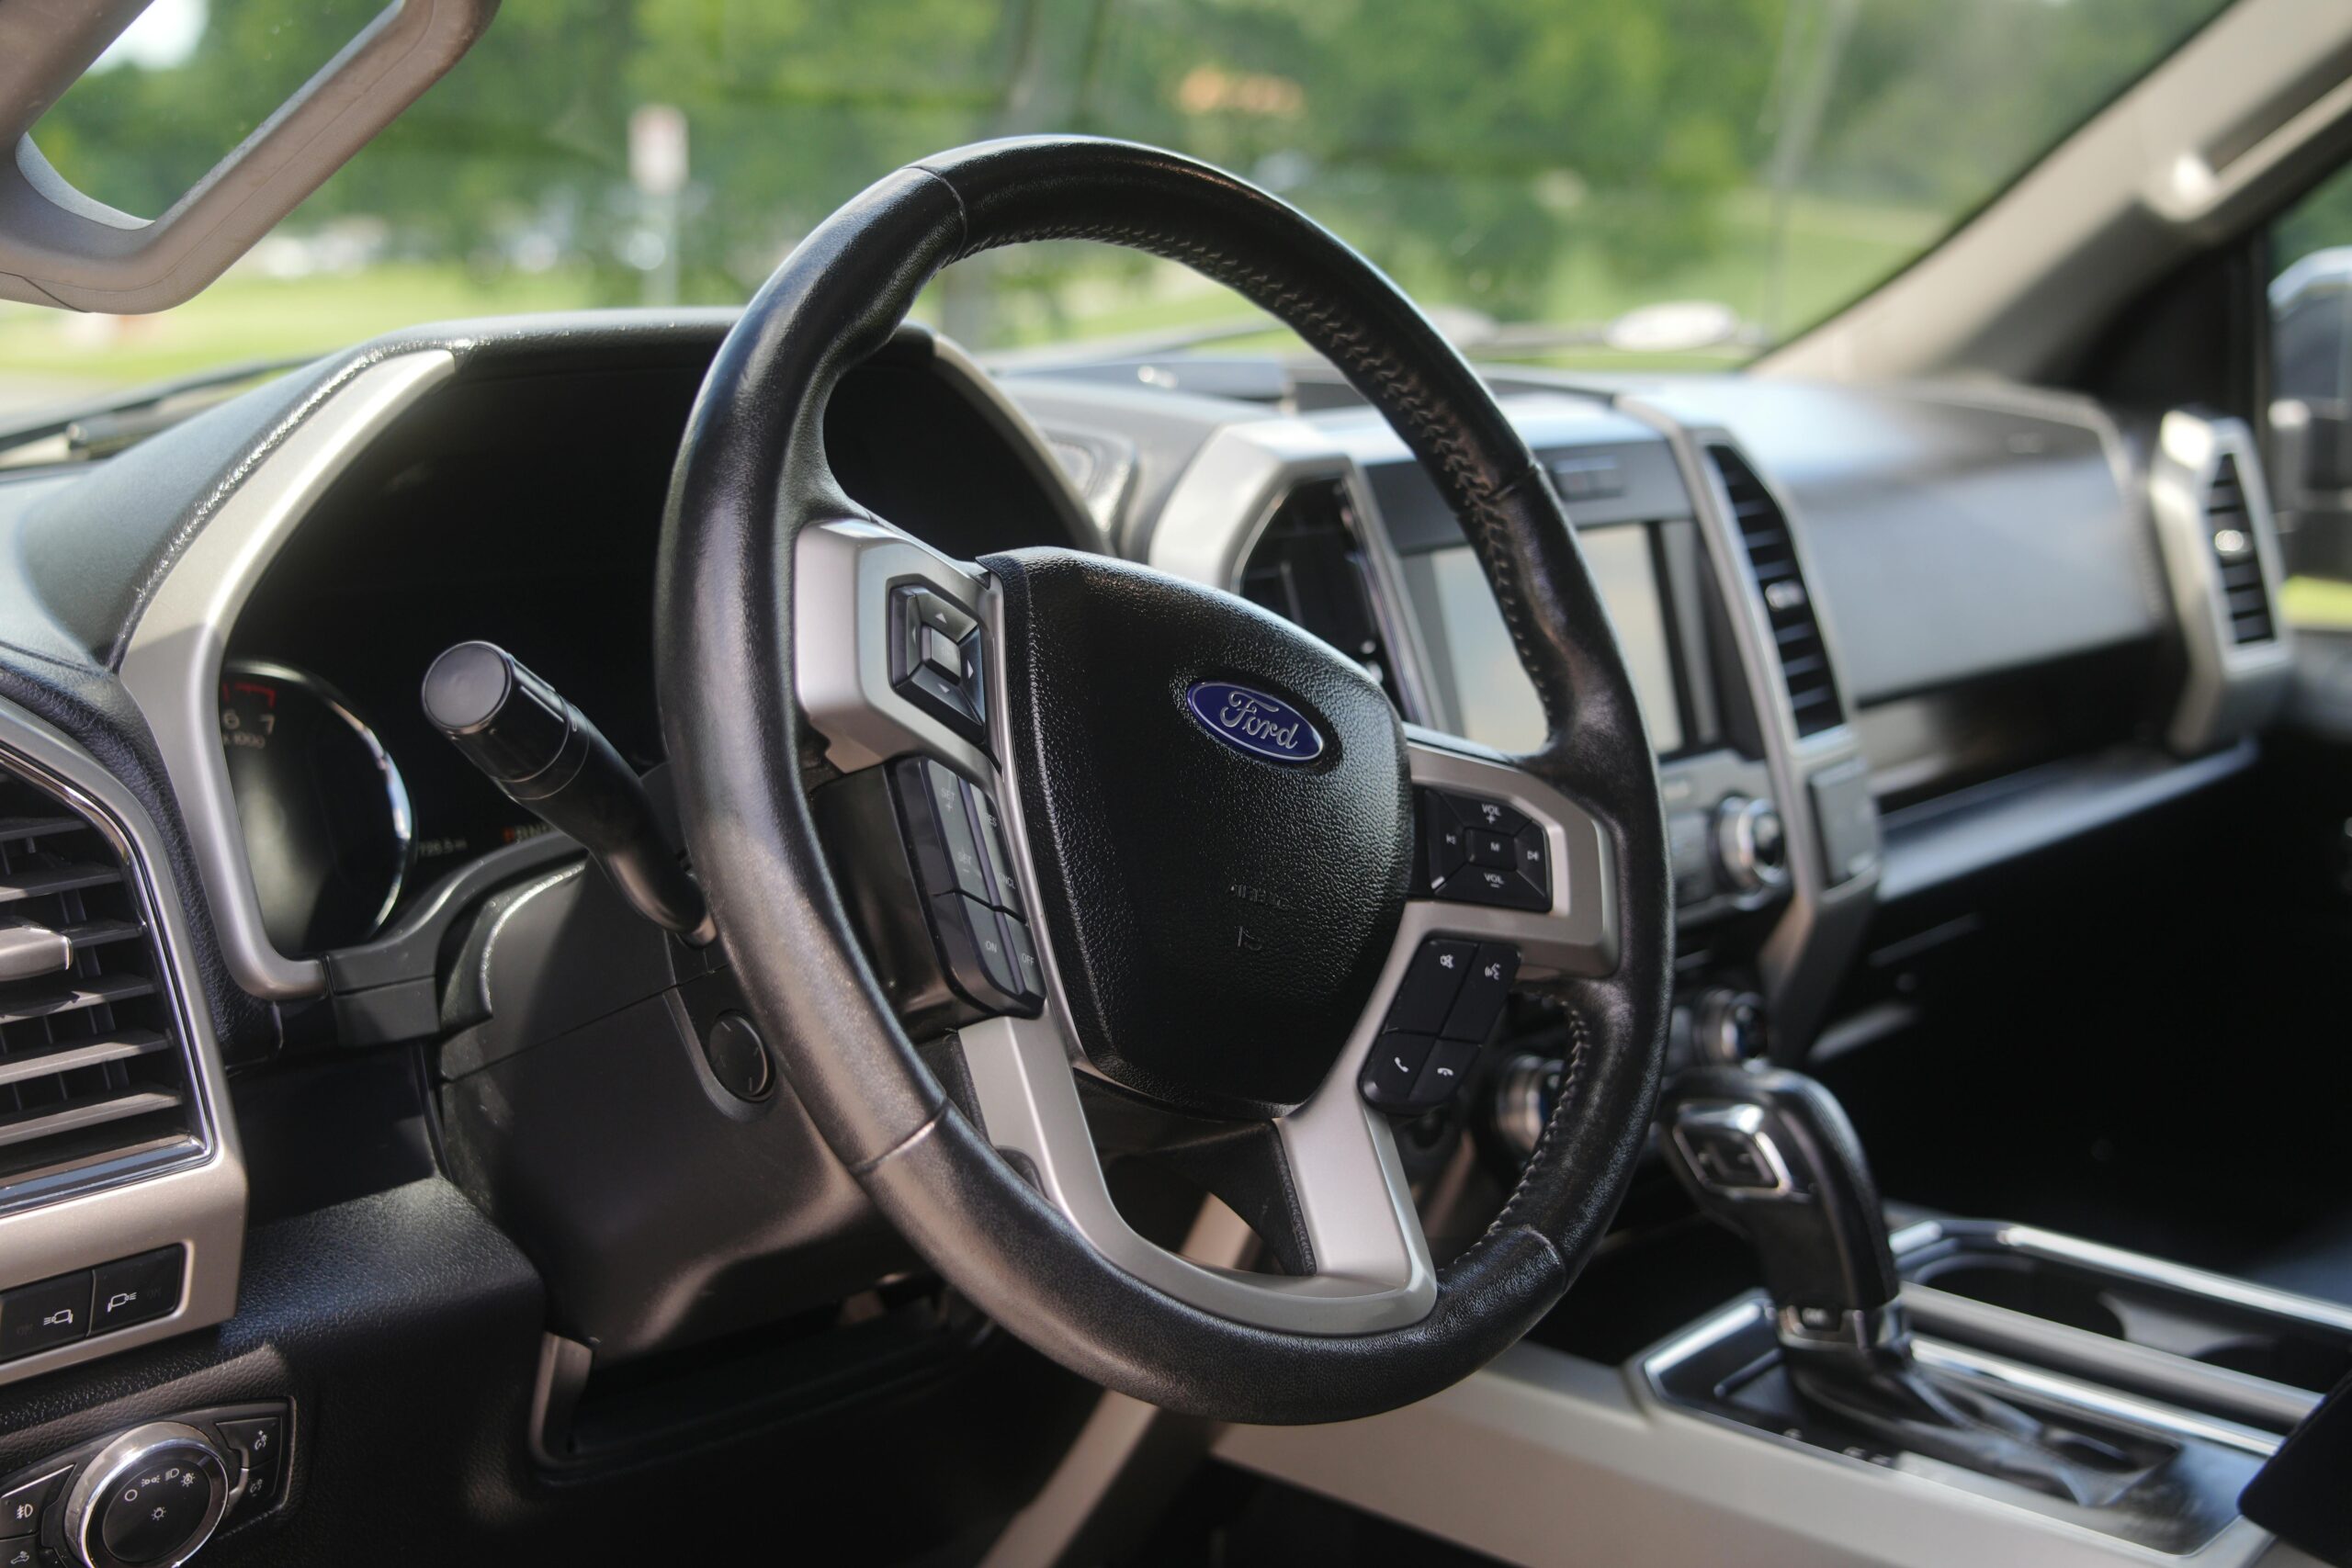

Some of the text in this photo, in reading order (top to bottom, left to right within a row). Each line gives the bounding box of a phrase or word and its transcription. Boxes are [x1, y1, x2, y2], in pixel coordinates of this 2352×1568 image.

[223, 709, 275, 735] 6 7
[1220, 691, 1299, 750] Ford
[942, 788, 956, 801] SET
[1482, 804, 1501, 817] VOL
[1490, 841, 1500, 852] M
[958, 852, 972, 865] SET
[1483, 873, 1505, 886] VOL
[986, 941, 998, 953] ON
[1022, 953, 1035, 966] OFF
